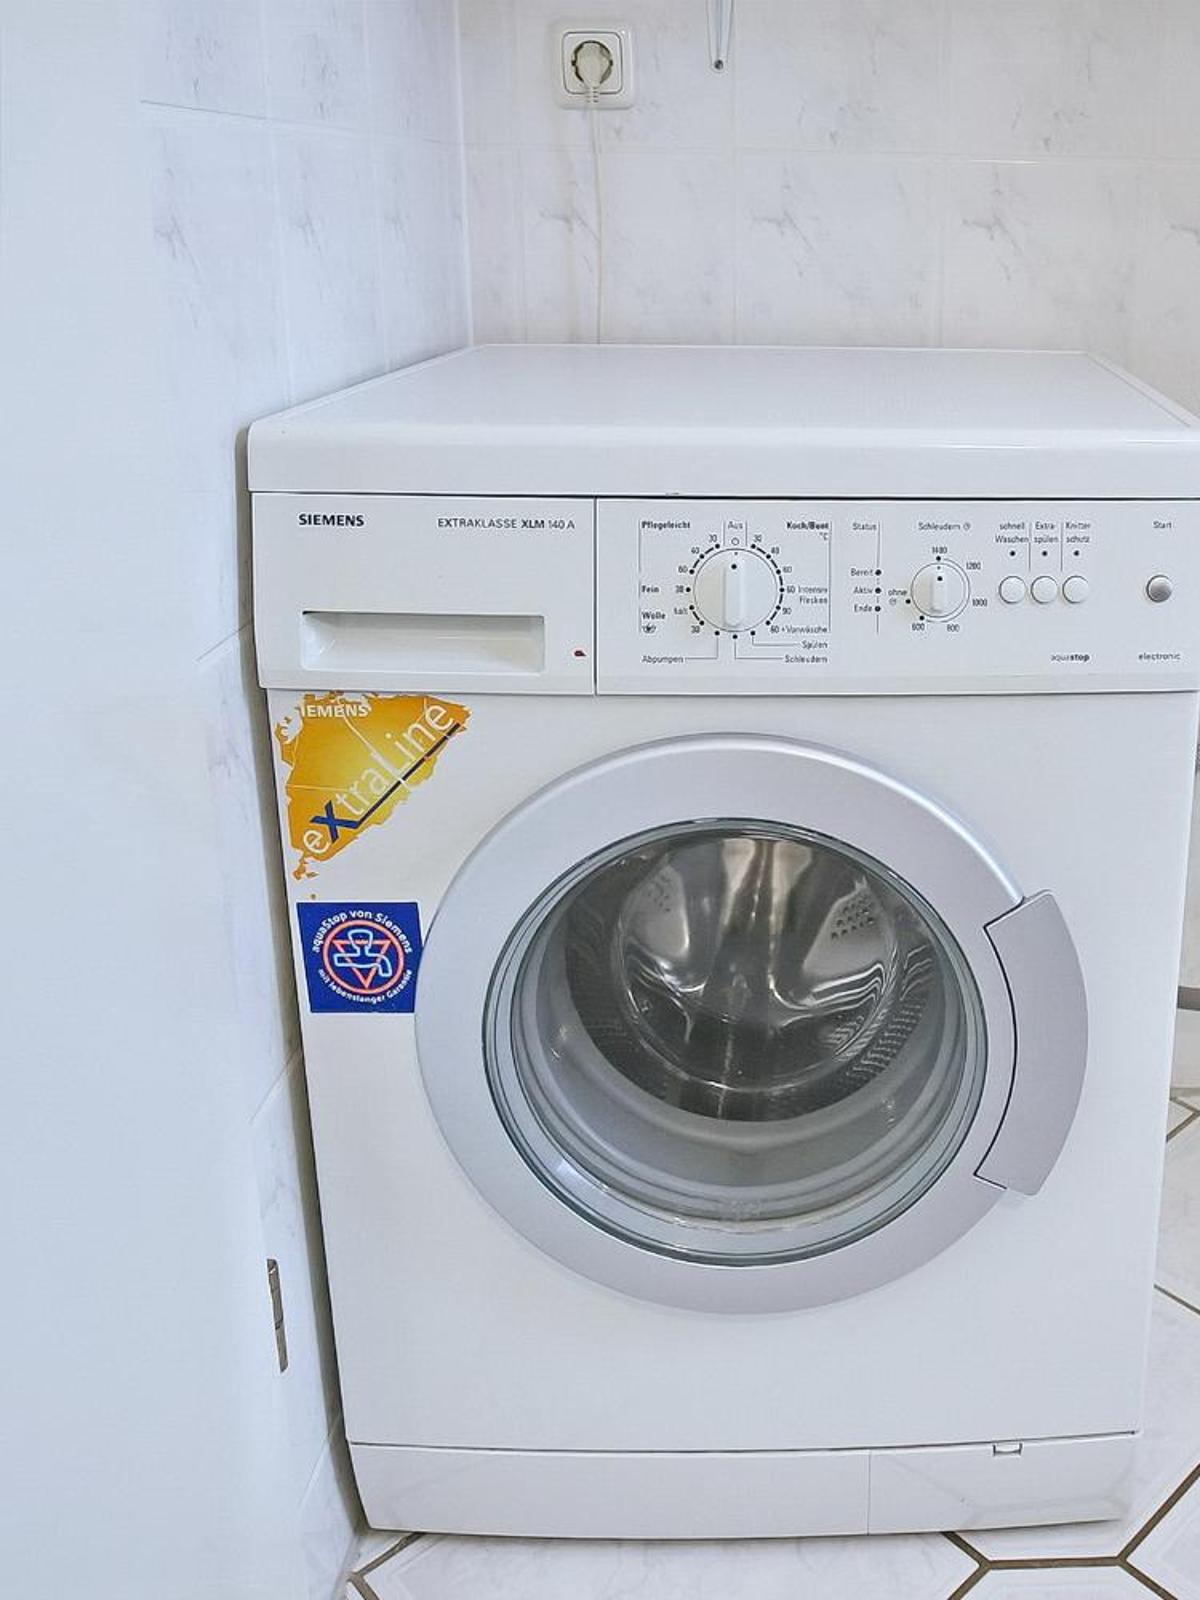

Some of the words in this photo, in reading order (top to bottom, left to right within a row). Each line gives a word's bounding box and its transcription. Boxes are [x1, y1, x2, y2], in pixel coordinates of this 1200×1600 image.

[298, 513, 364, 527] SIEMENS
[437, 518, 517, 528] EXTRAKLASSE
[521, 519, 545, 529] XLM
[548, 519, 565, 529] 140
[566, 520, 576, 529] A
[641, 521, 690, 530] Pflegeleicht
[728, 521, 744, 530] Aus
[852, 522, 877, 530] Status
[918, 522, 960, 530] Schleudern
[1000, 522, 1025, 530] schnell
[1152, 521, 1172, 530] Start
[994, 534, 1029, 543] Waschen
[1034, 534, 1059, 544] spülen
[966, 562, 981, 570] 1200
[850, 568, 874, 576] Bereit
[642, 585, 660, 593] Fein
[853, 586, 873, 594] Aktiv
[888, 588, 908, 596] ohne
[972, 598, 988, 607] 1000
[854, 604, 872, 612] Ende
[642, 611, 666, 620] Wolle
[802, 640, 828, 650] Spülen
[642, 655, 684, 664] Abpumpen
[784, 654, 828, 664] Schleudern
[1138, 652, 1181, 660] electronic
[348, 910, 373, 920] von
[374, 912, 413, 954] Siemens
